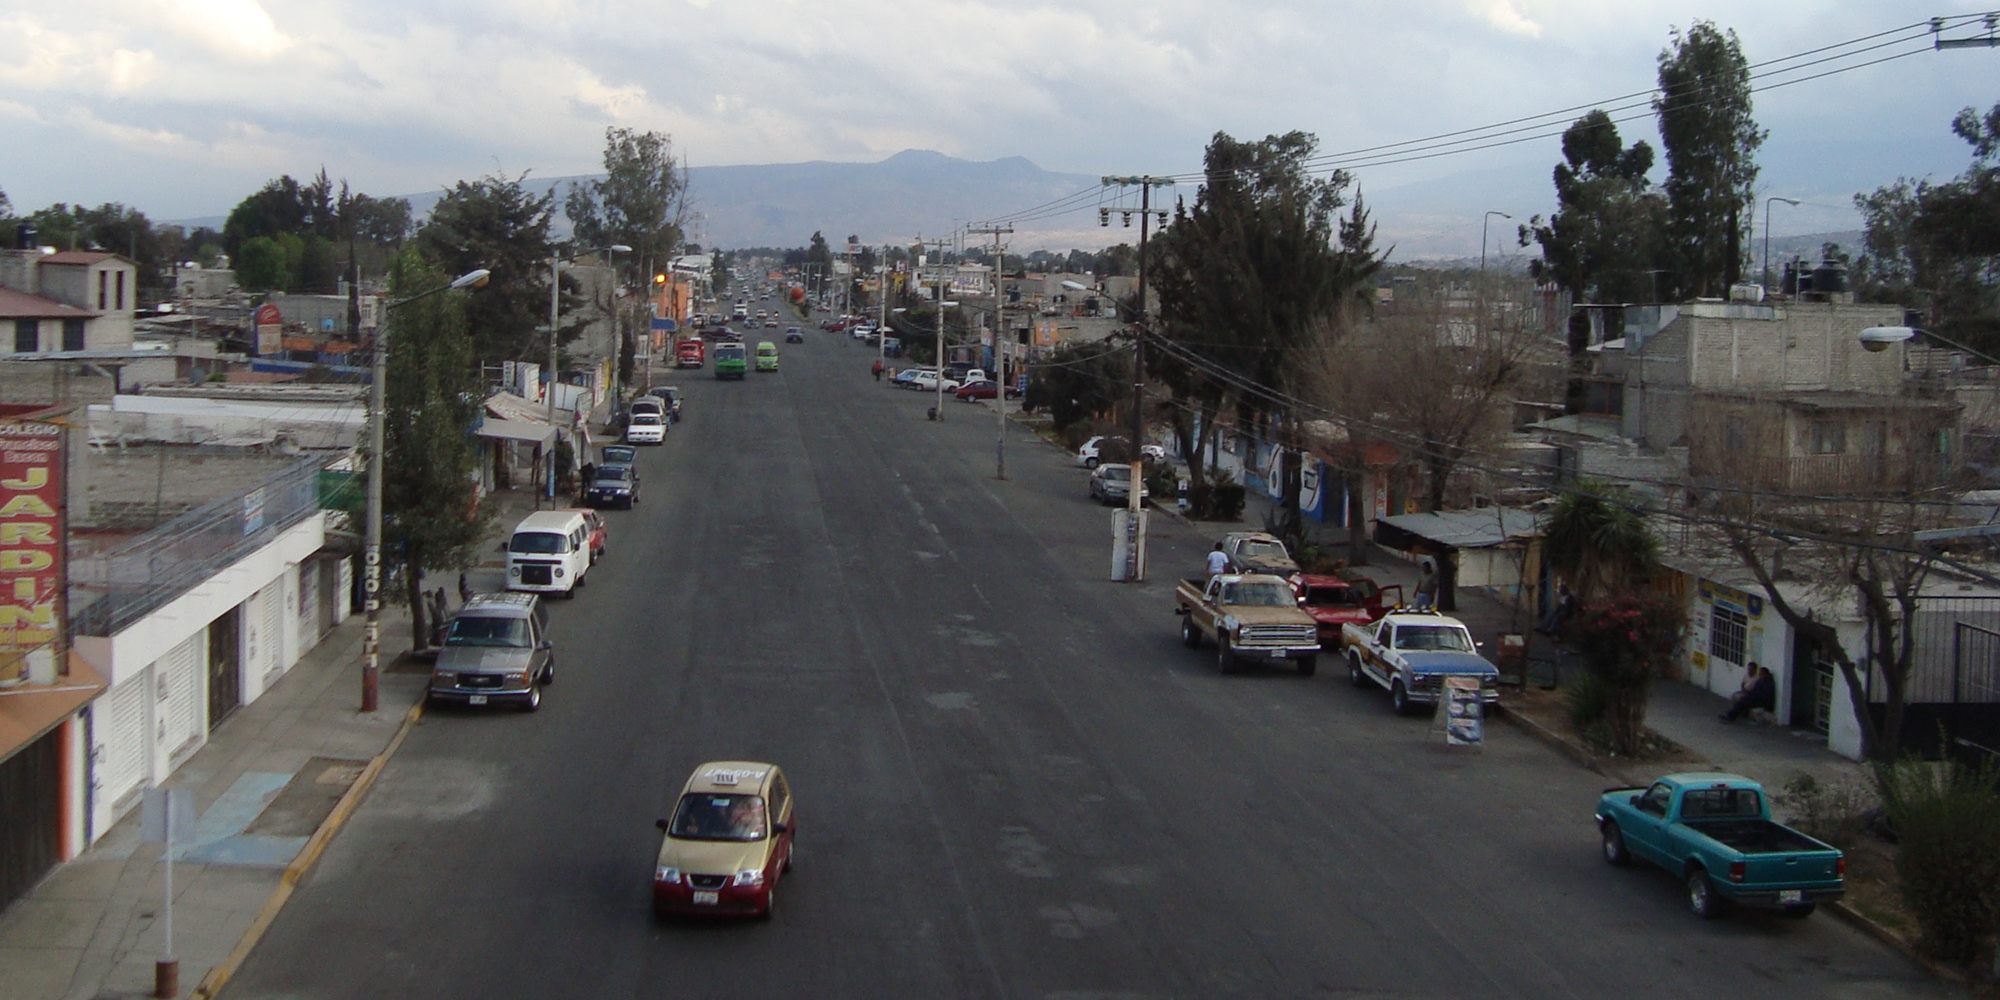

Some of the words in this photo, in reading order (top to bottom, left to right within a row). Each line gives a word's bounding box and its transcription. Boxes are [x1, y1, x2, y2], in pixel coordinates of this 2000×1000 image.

[0, 425, 59, 435] COLEGIO
[0, 467, 56, 626] JARDIN
[365, 551, 380, 593] ORO
